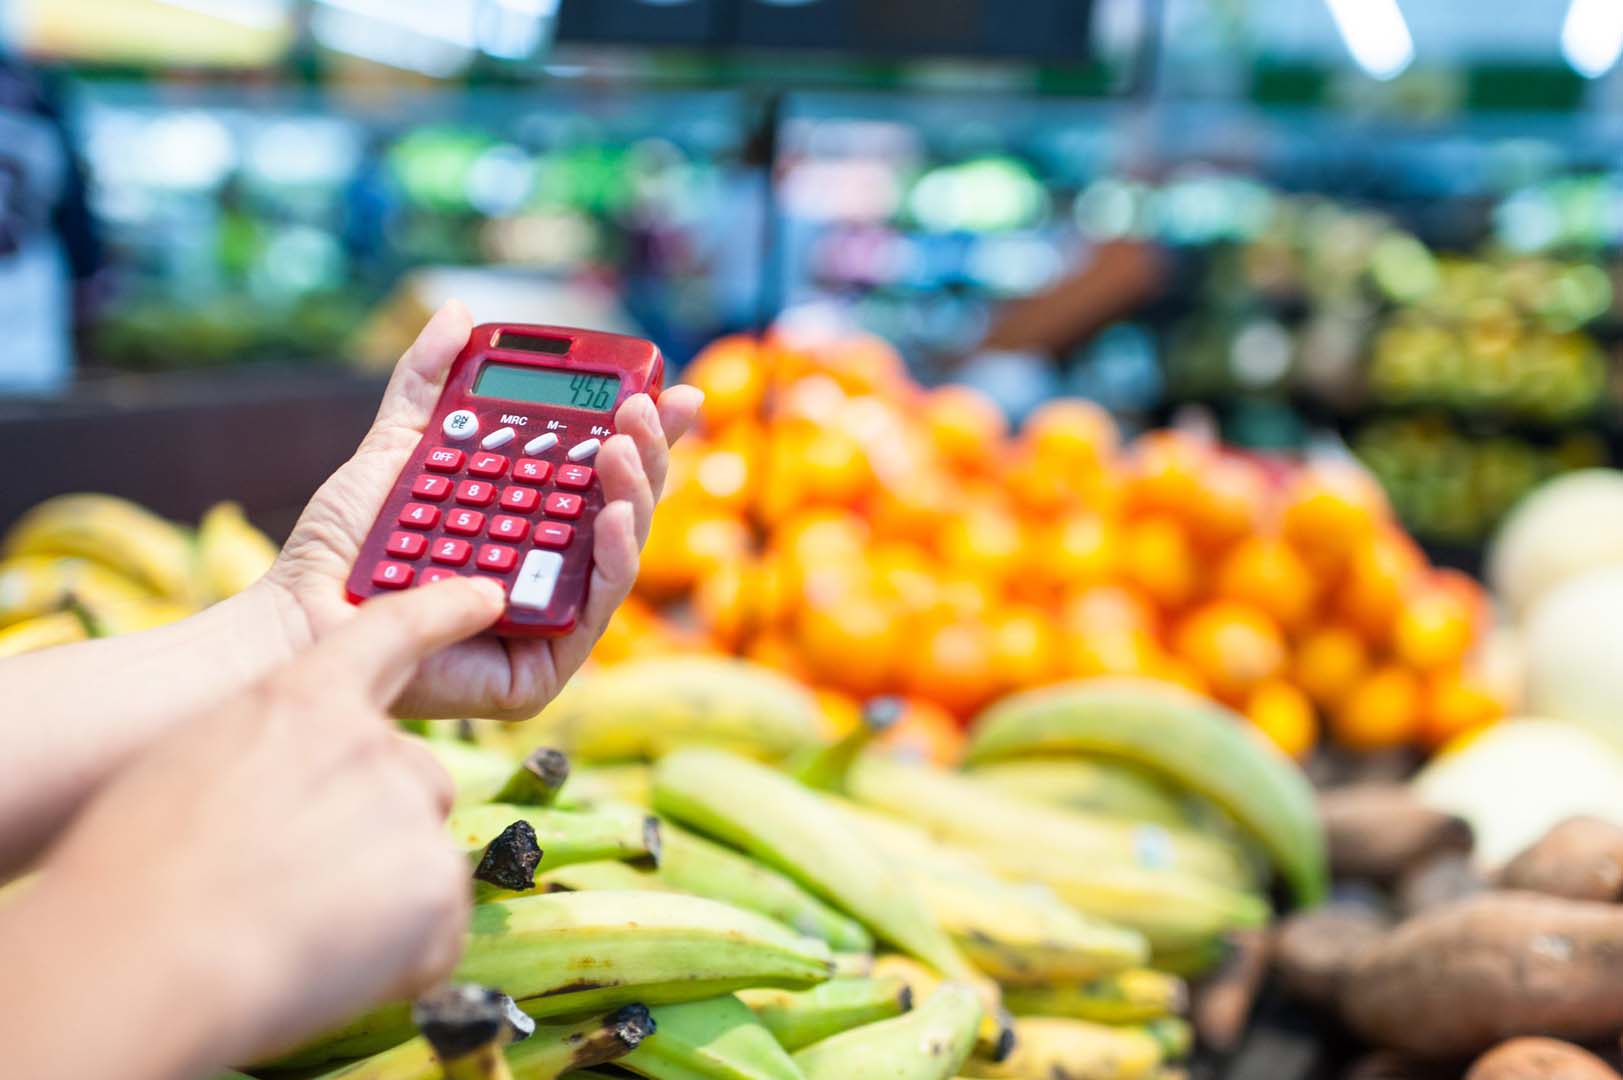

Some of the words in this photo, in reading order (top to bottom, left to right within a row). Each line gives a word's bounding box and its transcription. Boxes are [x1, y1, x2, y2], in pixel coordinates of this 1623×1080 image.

[500, 414, 528, 426] MRC
[590, 426, 612, 437] M+
[432, 451, 453, 462] OFF
[524, 463, 536, 475] %
[425, 479, 437, 491] 7
[468, 484, 479, 496] 8
[511, 490, 524, 502] 9
[411, 507, 423, 519] 4
[457, 513, 470, 525] 5
[500, 519, 513, 532] 6
[400, 536, 410, 549] 1
[442, 542, 455, 555] 2
[488, 548, 500, 561] 3
[384, 565, 397, 578] 0
